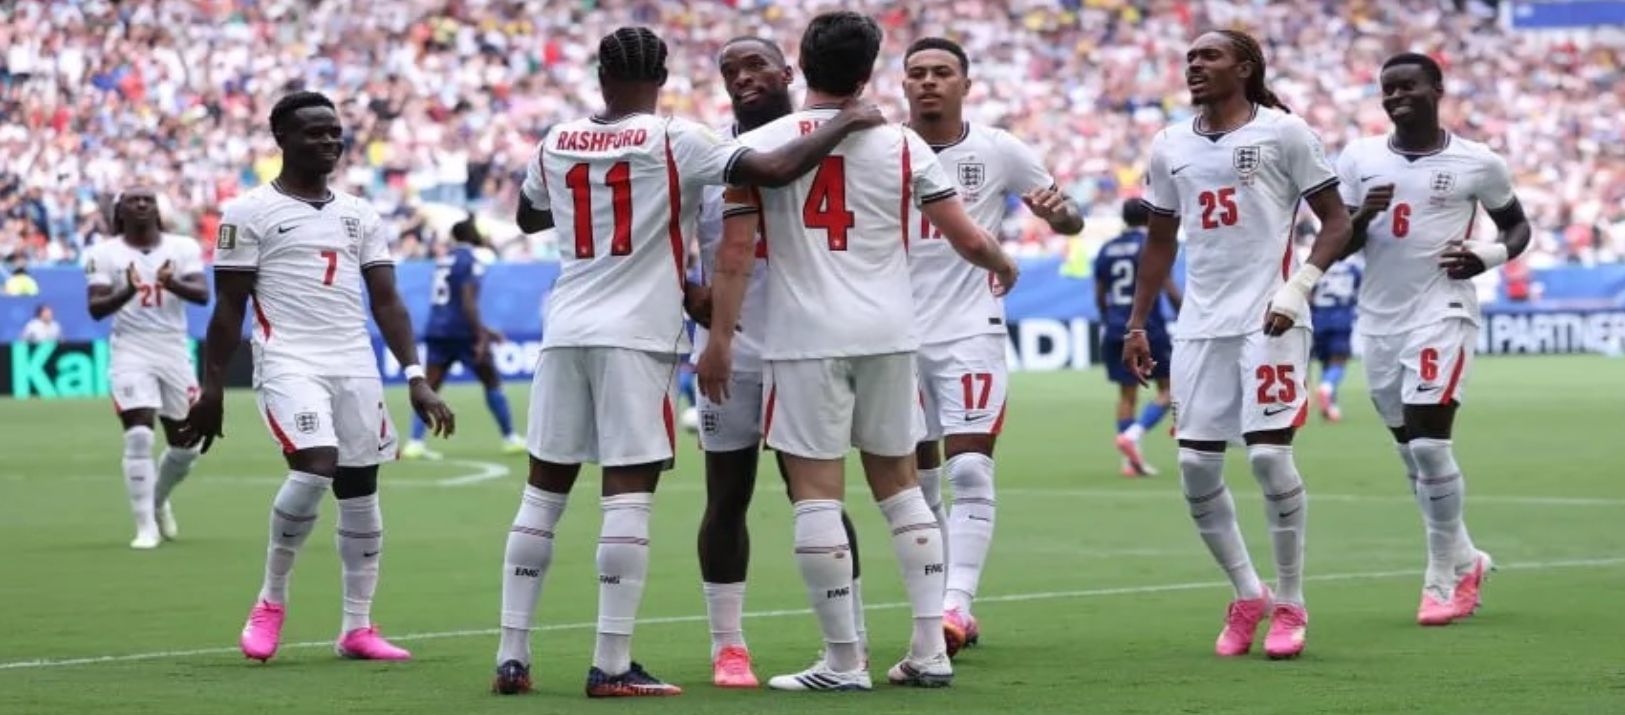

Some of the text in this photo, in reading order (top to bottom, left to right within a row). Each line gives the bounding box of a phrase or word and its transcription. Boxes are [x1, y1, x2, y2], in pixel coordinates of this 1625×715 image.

[556, 129, 647, 152] RASHFORD
[565, 161, 633, 259] 11
[803, 155, 855, 251] 4
[1199, 187, 1238, 230] 25
[1392, 203, 1411, 238] 6
[321, 251, 337, 286] 7
[139, 284, 163, 307] 21
[1420, 348, 1439, 382] 6
[961, 373, 993, 409] 17
[1256, 364, 1297, 404] 25
[515, 566, 540, 578] ENG
